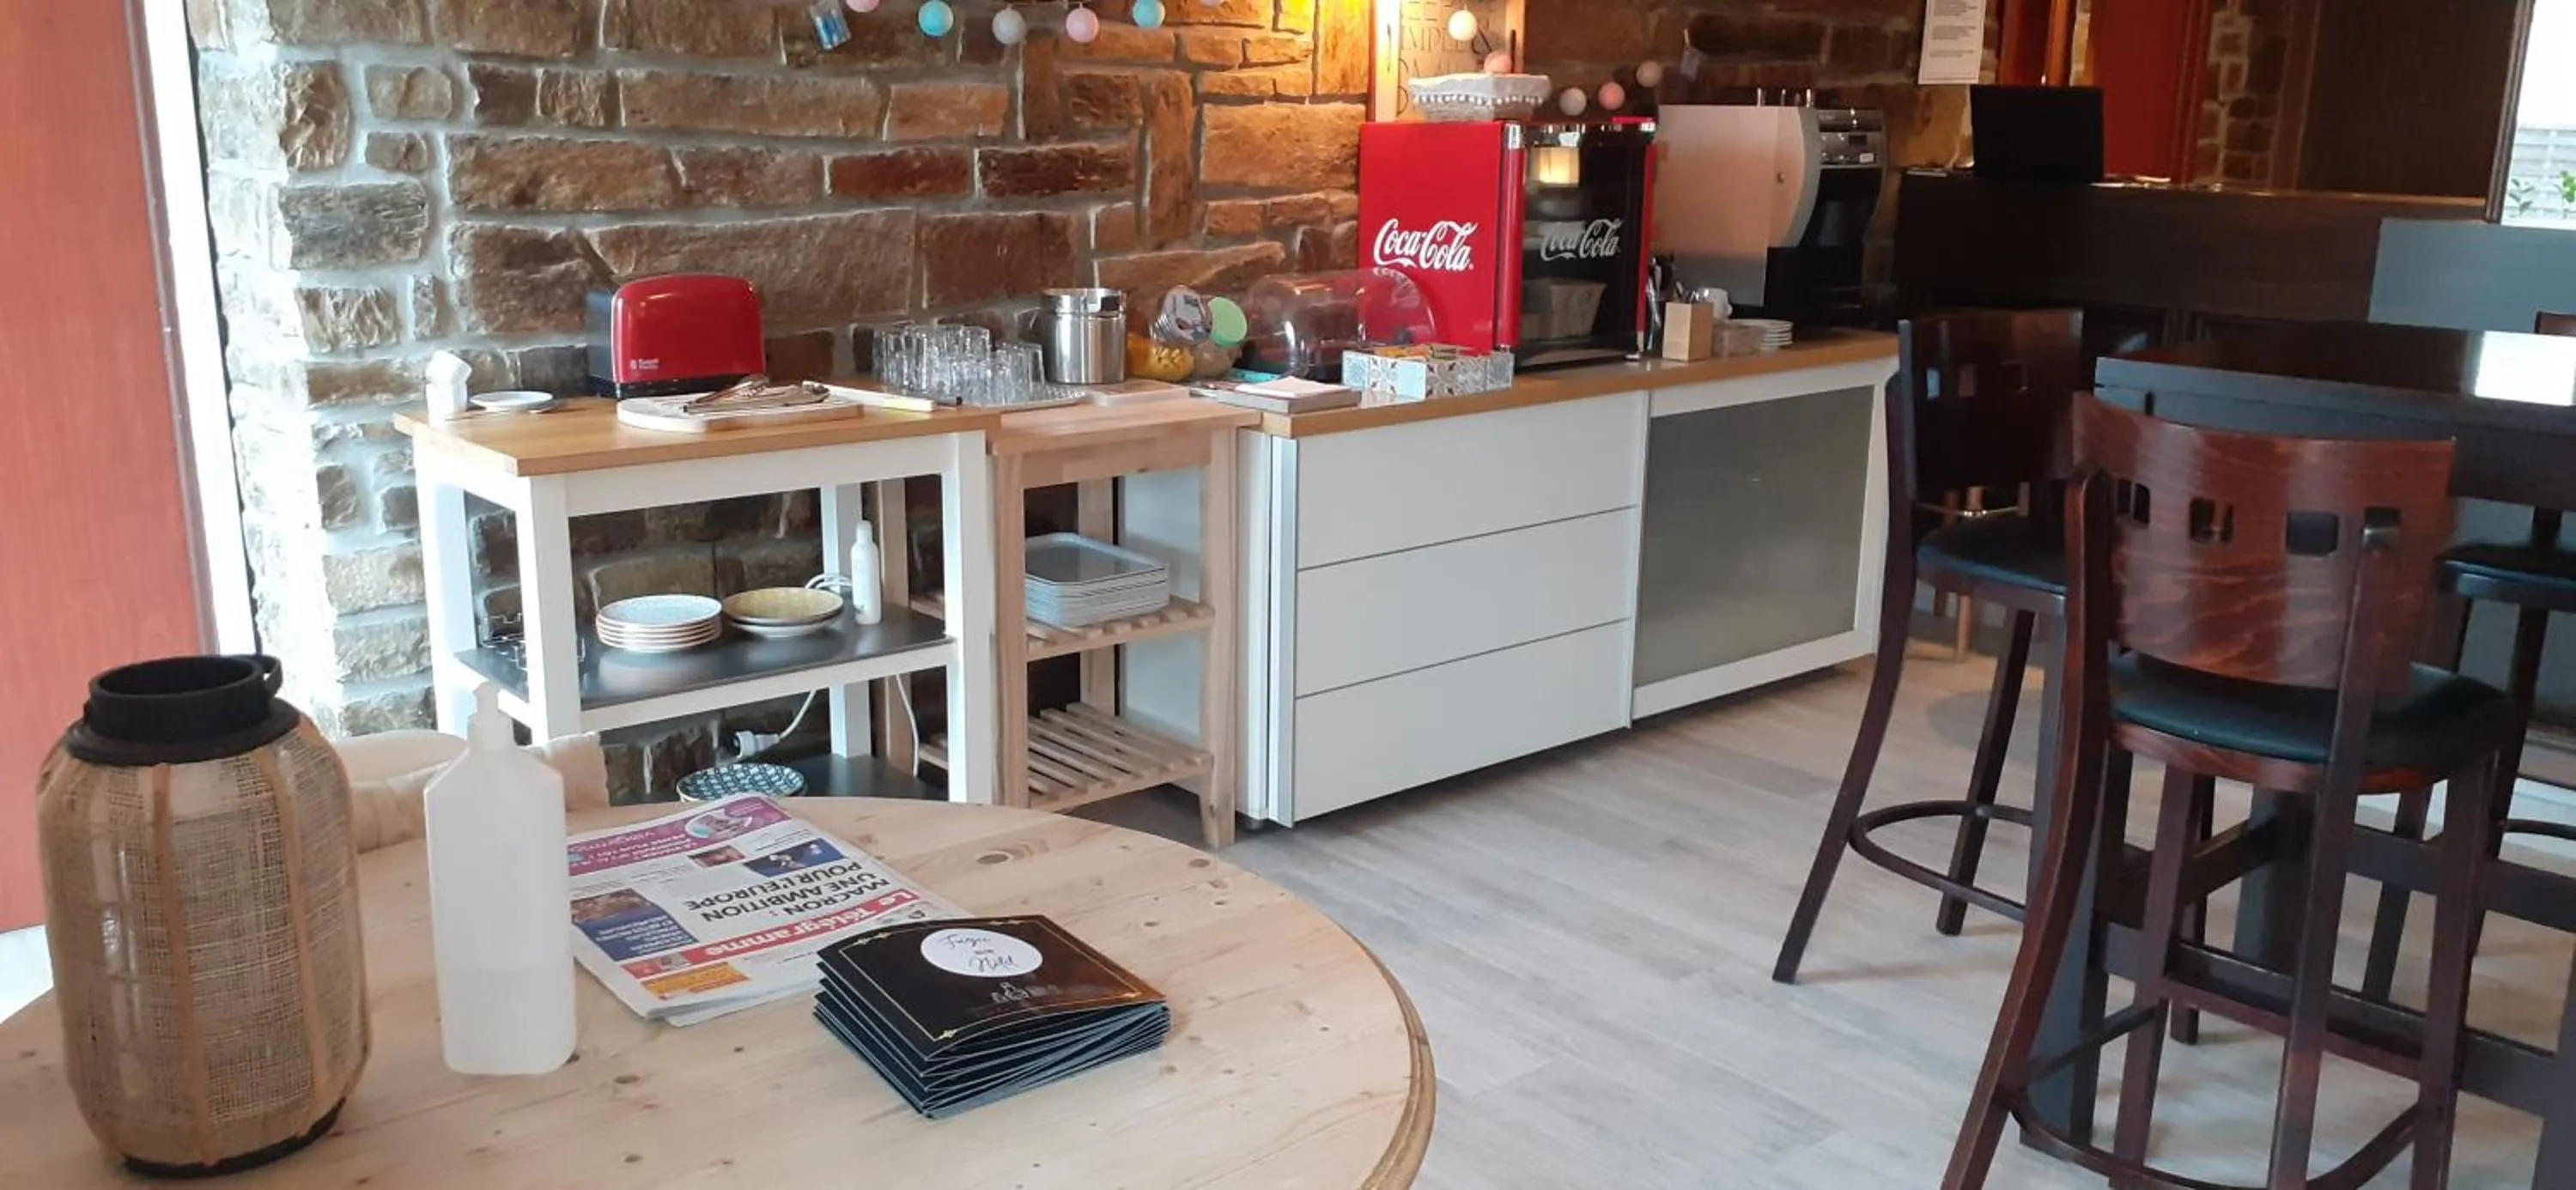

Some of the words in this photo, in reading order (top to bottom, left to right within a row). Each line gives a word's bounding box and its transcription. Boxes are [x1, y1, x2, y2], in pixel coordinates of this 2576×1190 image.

[1374, 218, 1478, 271] Coca-Cola
[1540, 219, 1622, 261] Coca-Cola
[797, 861, 864, 885] POUR
[830, 871, 878, 893] UNE
[701, 885, 826, 922] AMBITION
[785, 878, 890, 916] MACRON
[878, 890, 914, 907] Le
[703, 906, 876, 956] Télégramme
